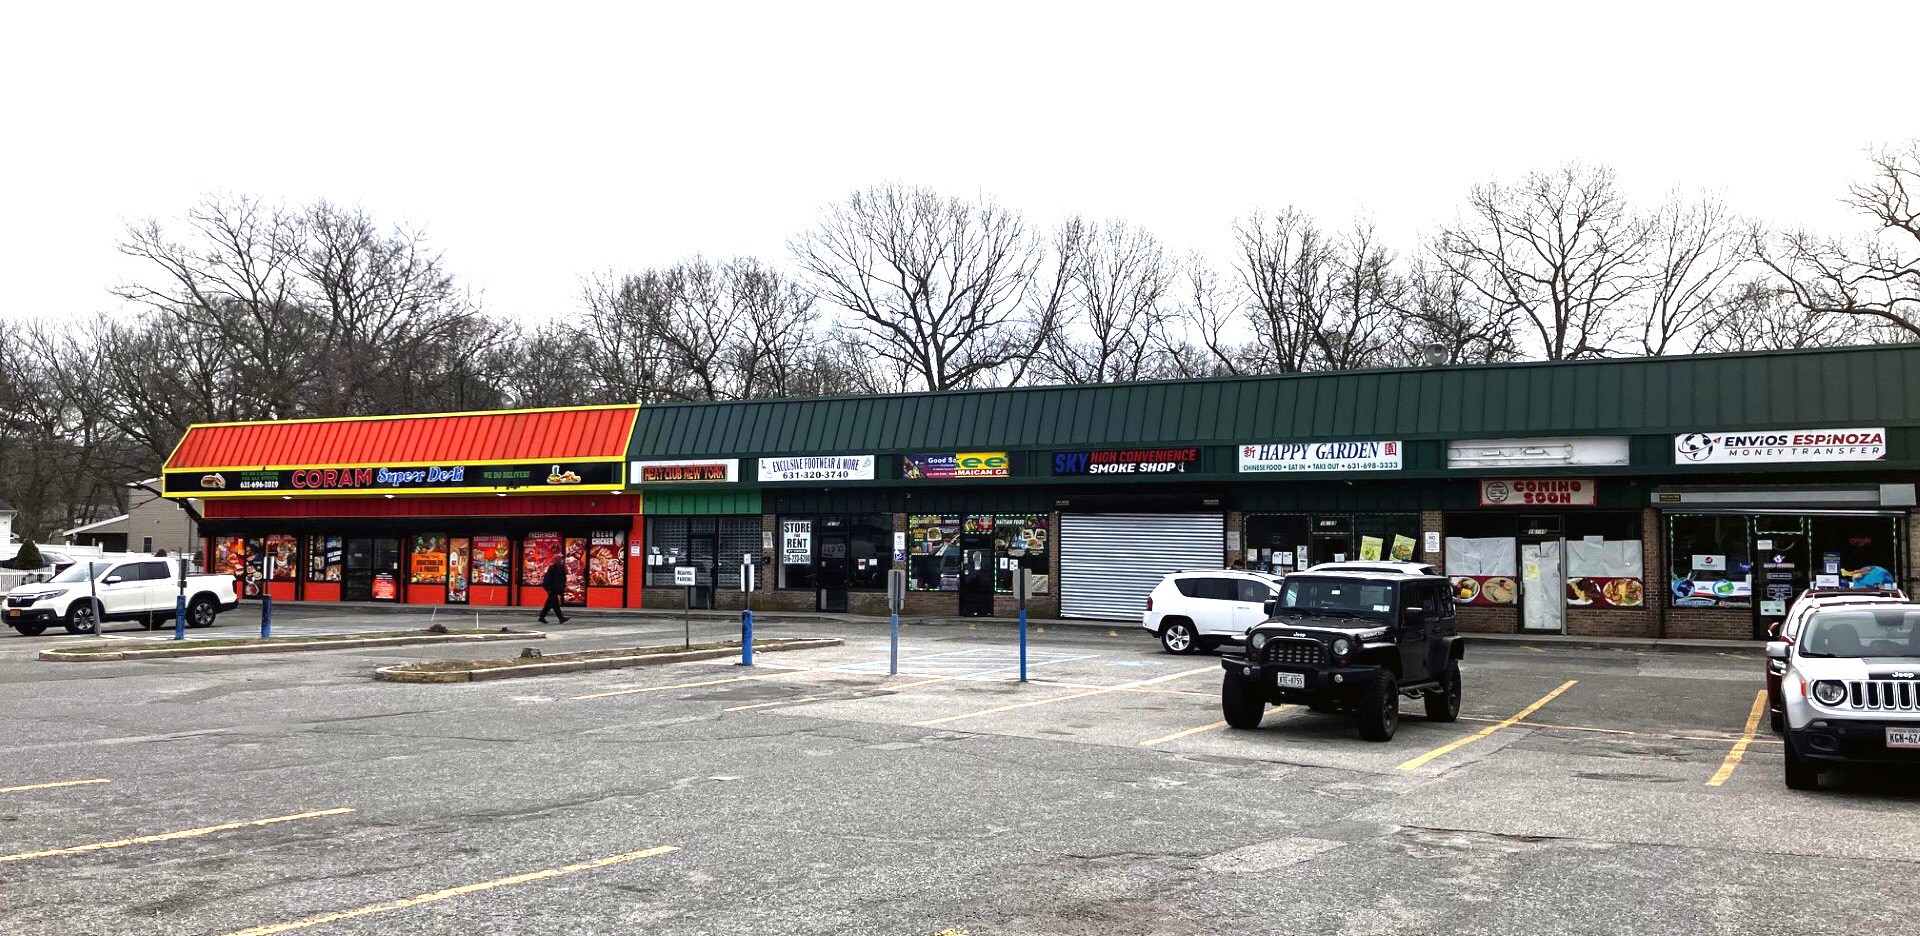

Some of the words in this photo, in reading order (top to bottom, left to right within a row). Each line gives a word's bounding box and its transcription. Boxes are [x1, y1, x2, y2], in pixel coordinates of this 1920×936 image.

[1258, 442, 1311, 461] HAPPY
[1315, 441, 1382, 460] GARDEN
[1728, 448, 1784, 456] MONEY
[1791, 446, 1881, 456] TRANSFER
[772, 459, 803, 473] EXCLUSIVE
[803, 457, 836, 470] FOOTWEAR
[836, 458, 841, 469] &
[842, 457, 860, 471] MORE
[927, 456, 947, 464] Good
[1055, 452, 1089, 474] SKY
[1090, 451, 1117, 463] HIGH
[1119, 449, 1197, 462] CONVENIENCE
[1347, 461, 1398, 470] 631-698-3333
[664, 465, 682, 480] CLUB
[683, 464, 701, 480] NEW
[703, 464, 724, 479] YORK
[1089, 463, 1137, 474] SMOKE
[1138, 462, 1176, 473] SHOP
[291, 468, 373, 489] CORAM
[376, 466, 426, 487] Super
[427, 465, 465, 483] Deli
[782, 470, 849, 480] 631-320-3740
[1523, 492, 1571, 504] SOON
[784, 522, 811, 534] STORE
[786, 538, 808, 549] RENT
[1892, 671, 1915, 679] Jeep
